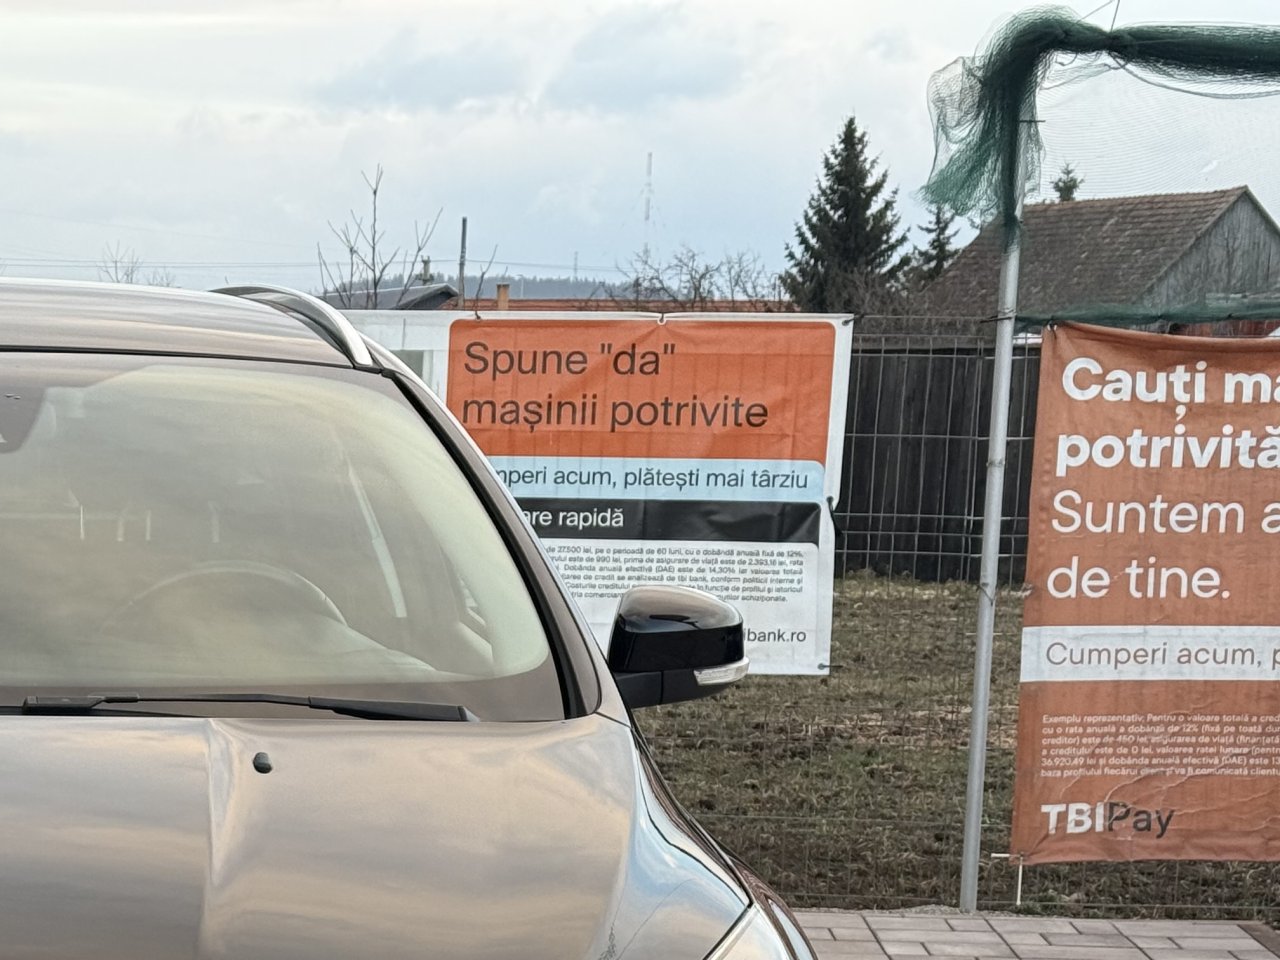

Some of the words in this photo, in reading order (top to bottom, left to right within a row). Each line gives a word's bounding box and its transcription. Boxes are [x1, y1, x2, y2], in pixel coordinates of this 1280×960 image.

[464, 341, 588, 380] Spune
[599, 342, 676, 375] "da"
[1062, 356, 1207, 419] Cauți
[462, 394, 598, 432] mașinii
[610, 393, 769, 432] potrivite
[553, 470, 617, 488] acum,
[624, 467, 700, 491] plătești
[706, 469, 744, 487] mai
[751, 468, 808, 489] târziu
[558, 508, 624, 530] rapidă
[1051, 489, 1245, 534] Suntem
[1047, 555, 1111, 599] de
[1125, 556, 1230, 599] tine.
[743, 627, 806, 642] ibank.ro
[1046, 642, 1168, 670] Cumperi
[1177, 646, 1262, 668] acum,
[1042, 714, 1081, 724] Exemplu
